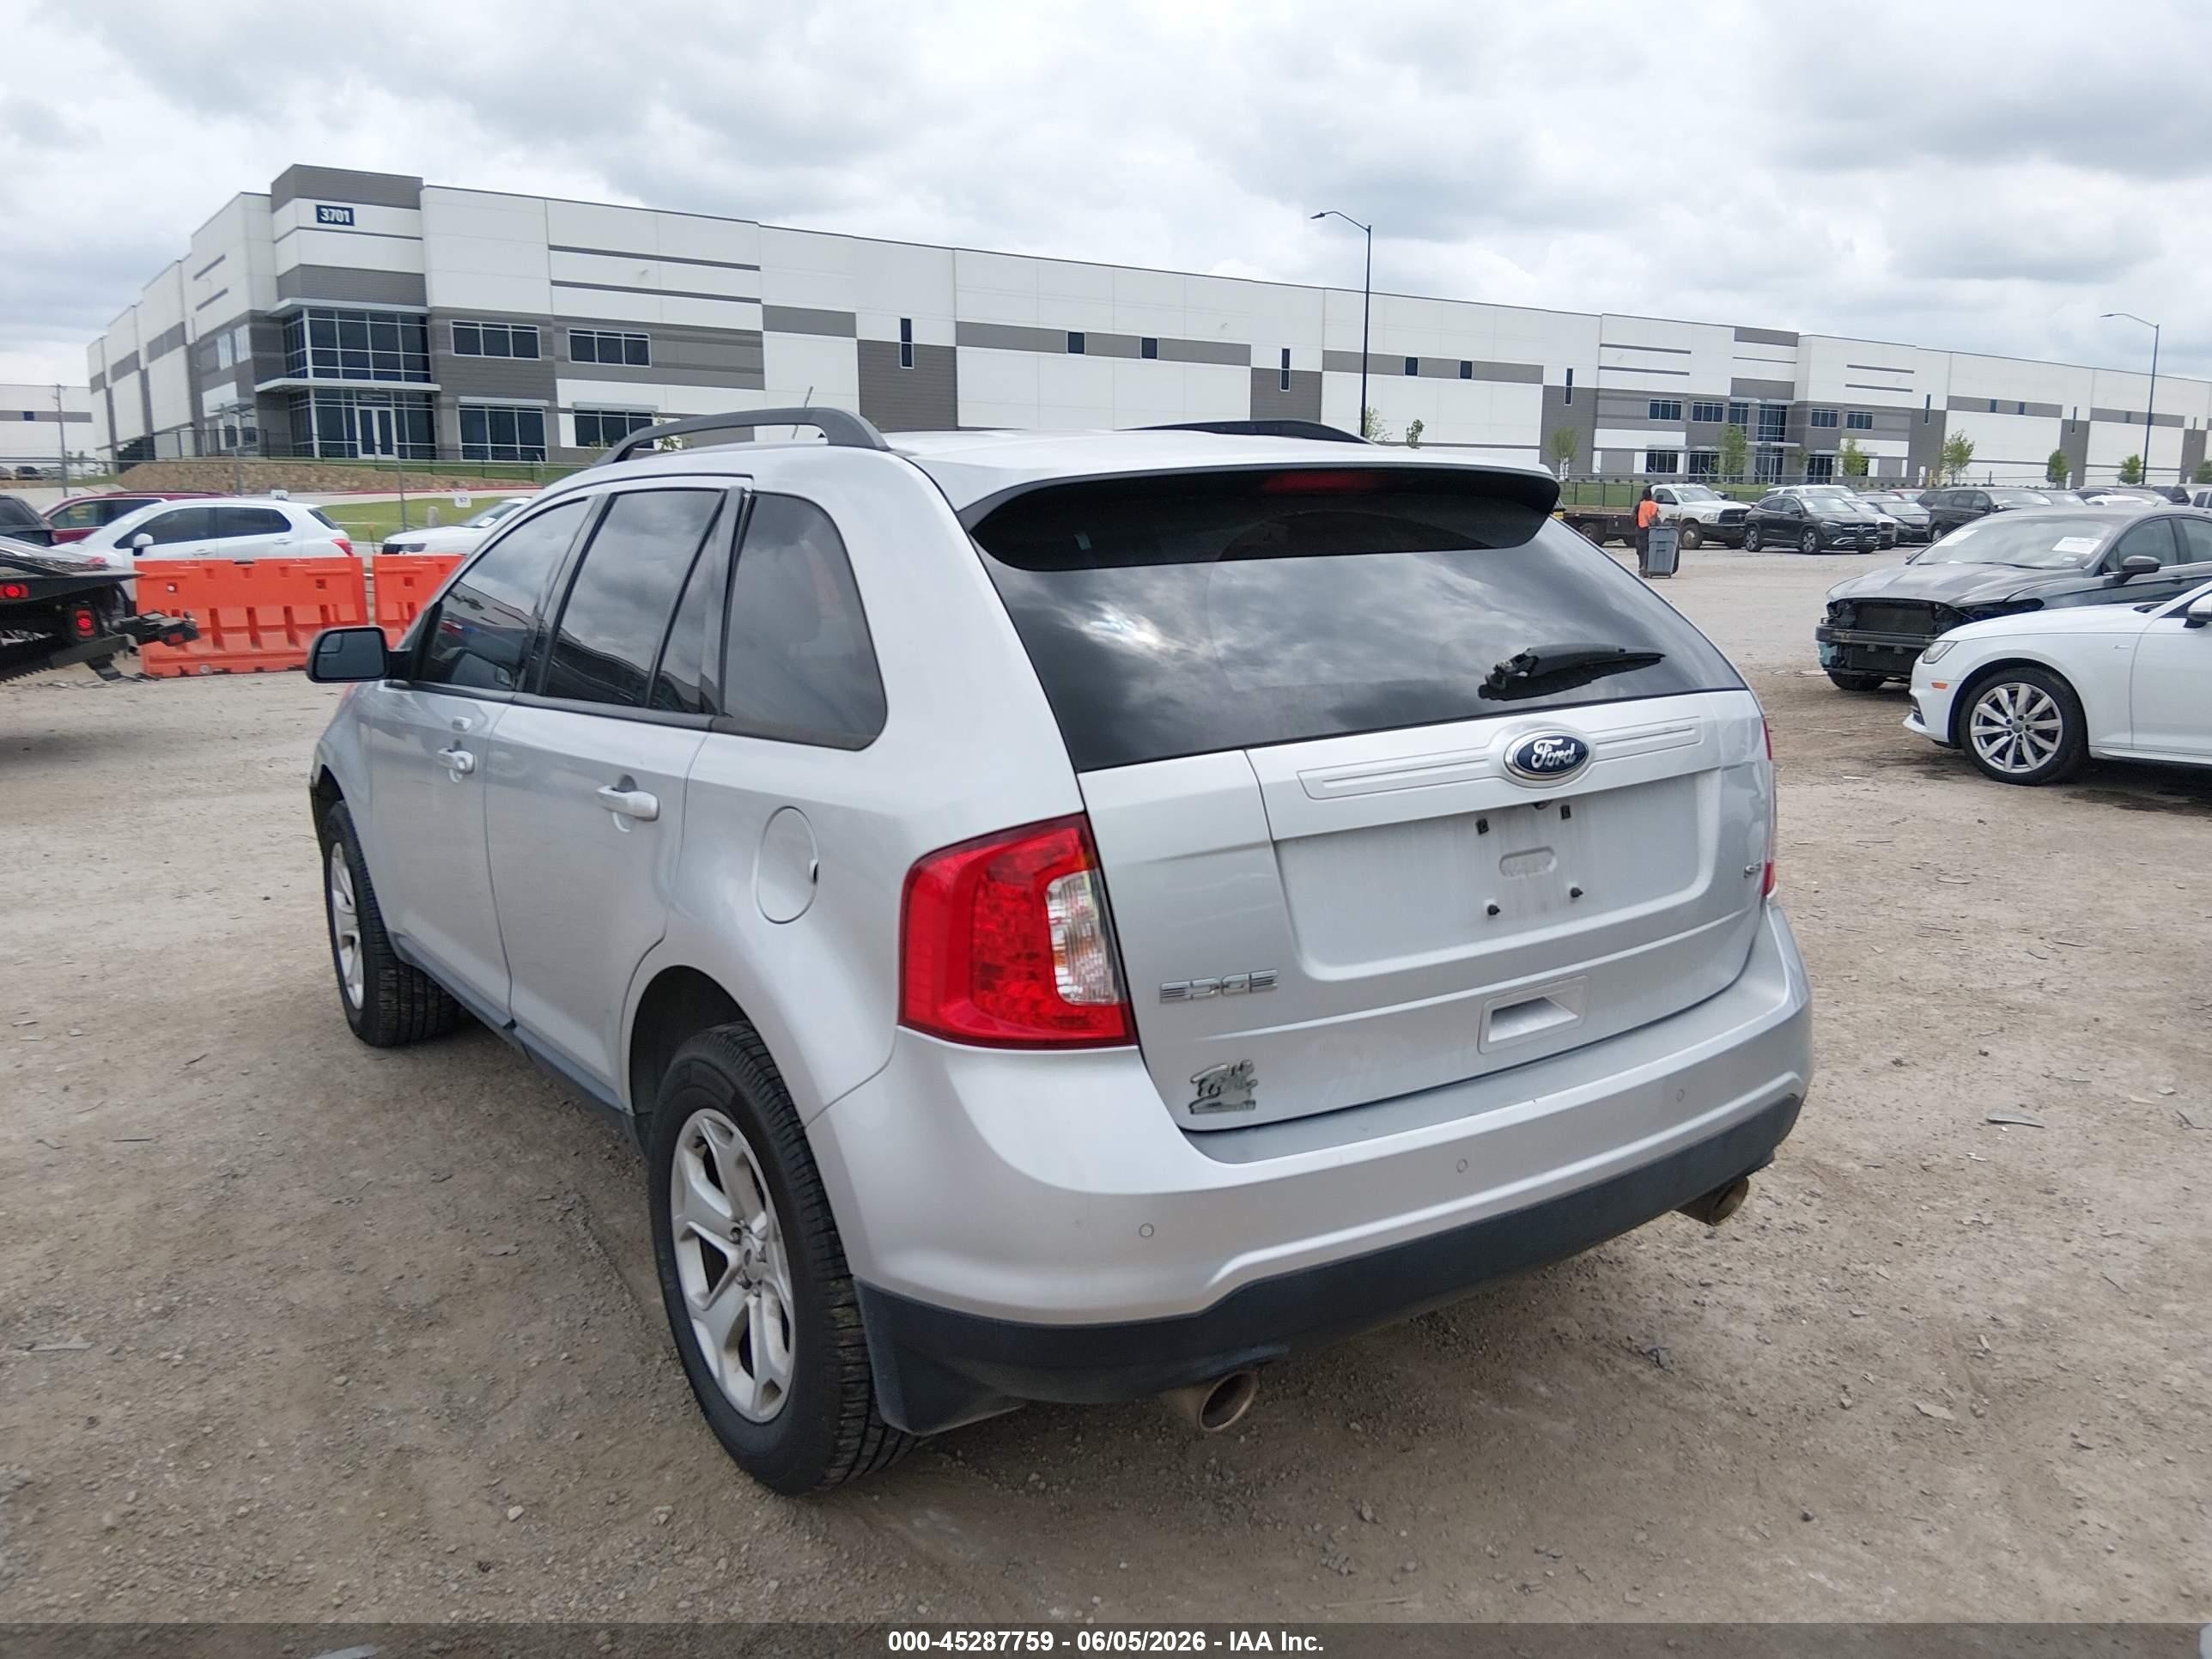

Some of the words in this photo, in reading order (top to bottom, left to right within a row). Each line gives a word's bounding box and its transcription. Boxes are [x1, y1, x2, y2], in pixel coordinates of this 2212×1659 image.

[320, 207, 350, 223] 3701
[1531, 738, 1577, 769] Ford
[1160, 969, 1279, 1002] EDGE
